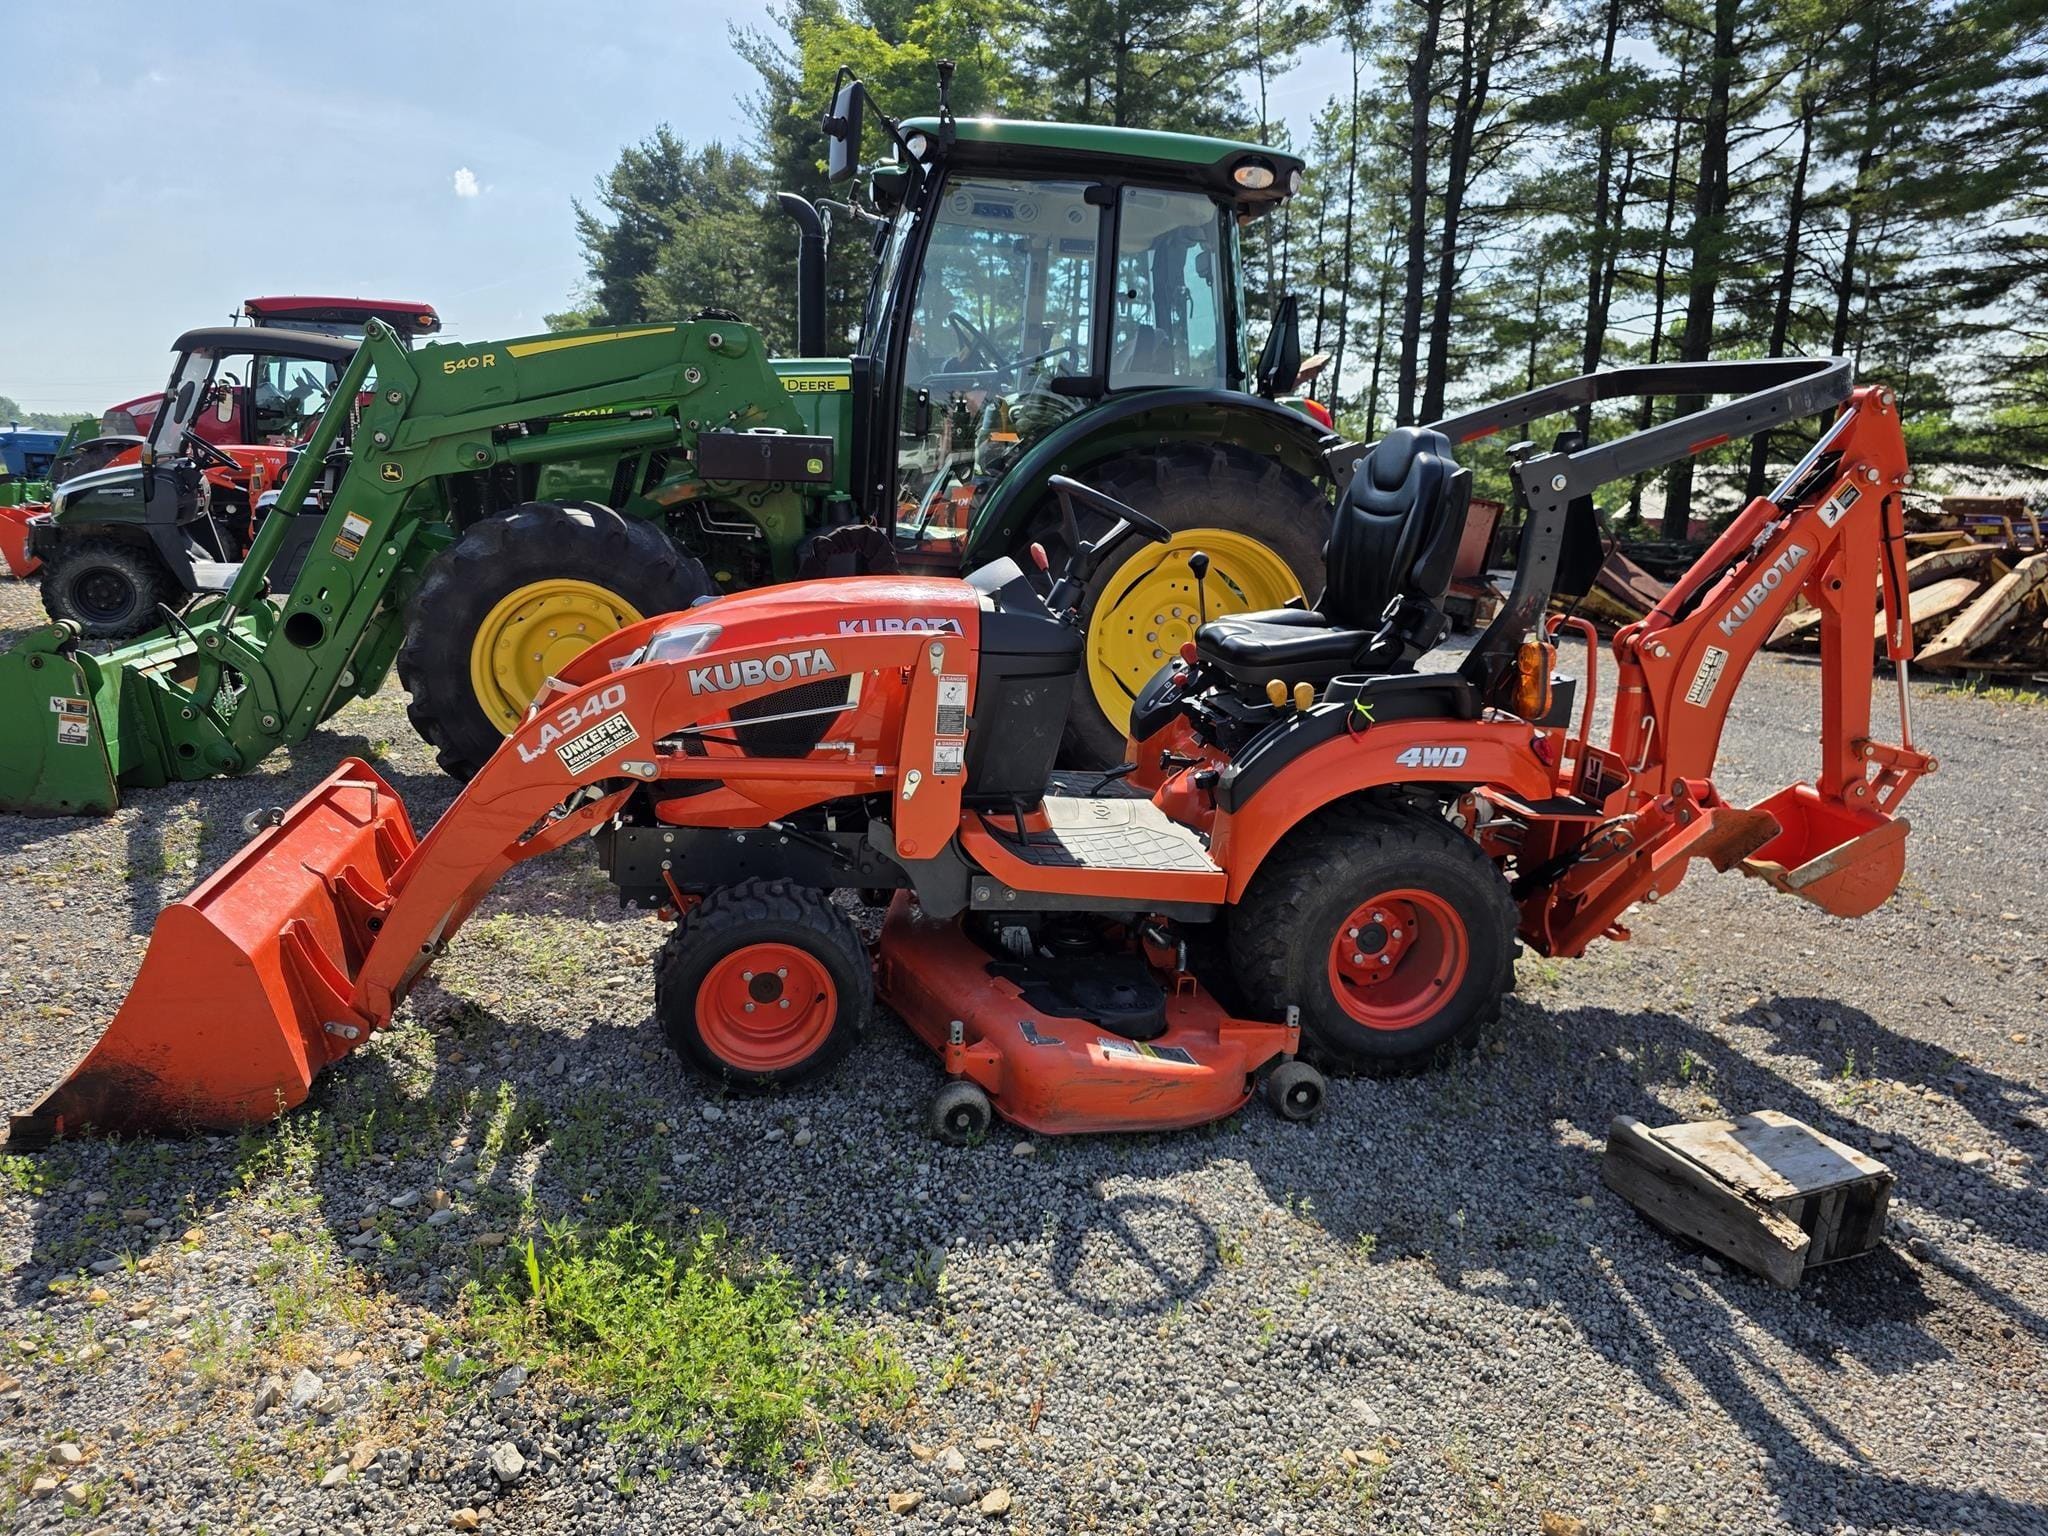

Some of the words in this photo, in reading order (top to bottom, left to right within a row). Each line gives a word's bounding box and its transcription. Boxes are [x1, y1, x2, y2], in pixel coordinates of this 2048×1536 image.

[443, 356, 479, 375] 540
[482, 353, 496, 368] R
[787, 379, 836, 391] DEERE
[1718, 543, 1809, 638] KUBOTA
[687, 648, 837, 696] KUBOTA
[1687, 649, 1718, 702] UNKEFER
[517, 684, 626, 763] LA340
[559, 716, 627, 759] UNKEFER
[613, 729, 630, 740] INC.
[1395, 746, 1468, 768] 4WD
